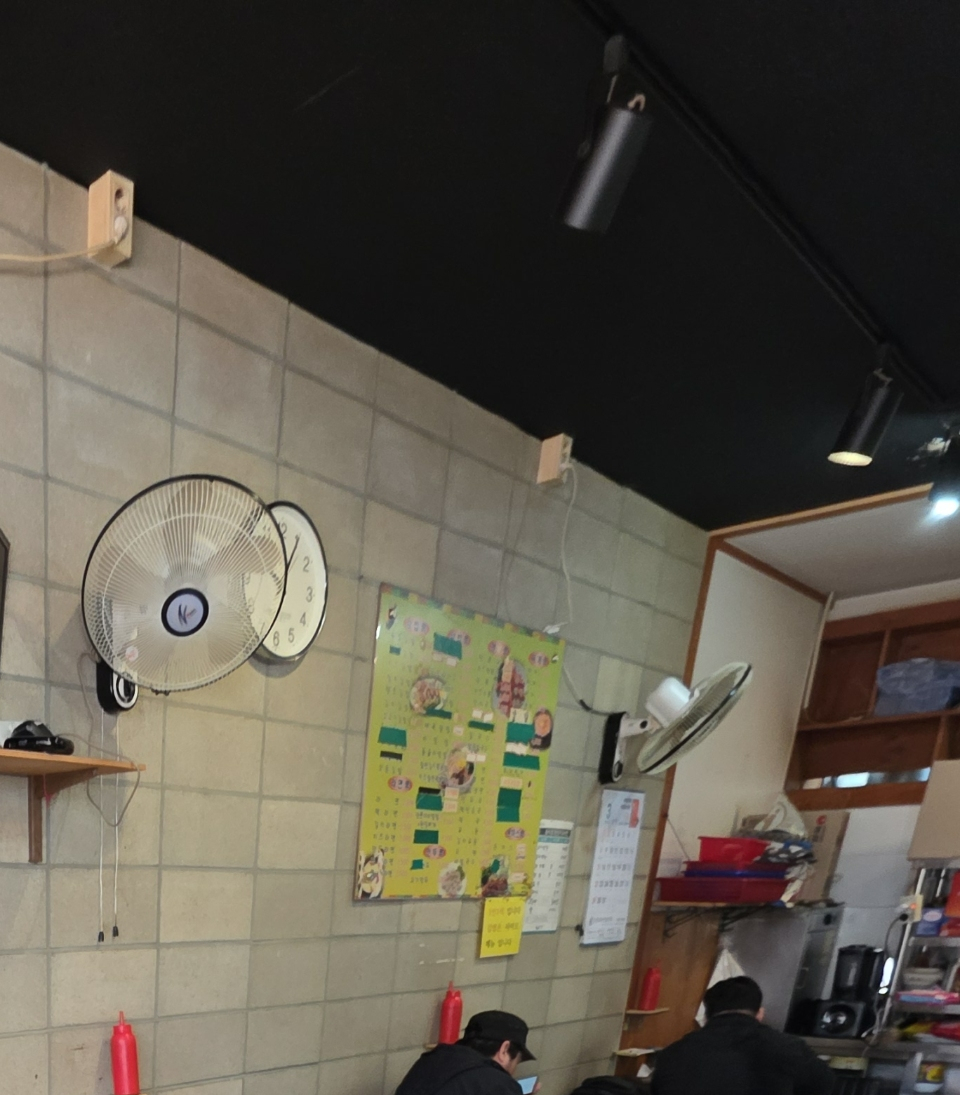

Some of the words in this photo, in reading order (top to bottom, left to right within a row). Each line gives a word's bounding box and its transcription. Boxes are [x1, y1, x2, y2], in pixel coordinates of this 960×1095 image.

[303, 556, 310, 572] 2
[306, 587, 313, 603] 3
[300, 612, 307, 627] 4
[273, 631, 280, 646] 6
[288, 628, 295, 643] 5
